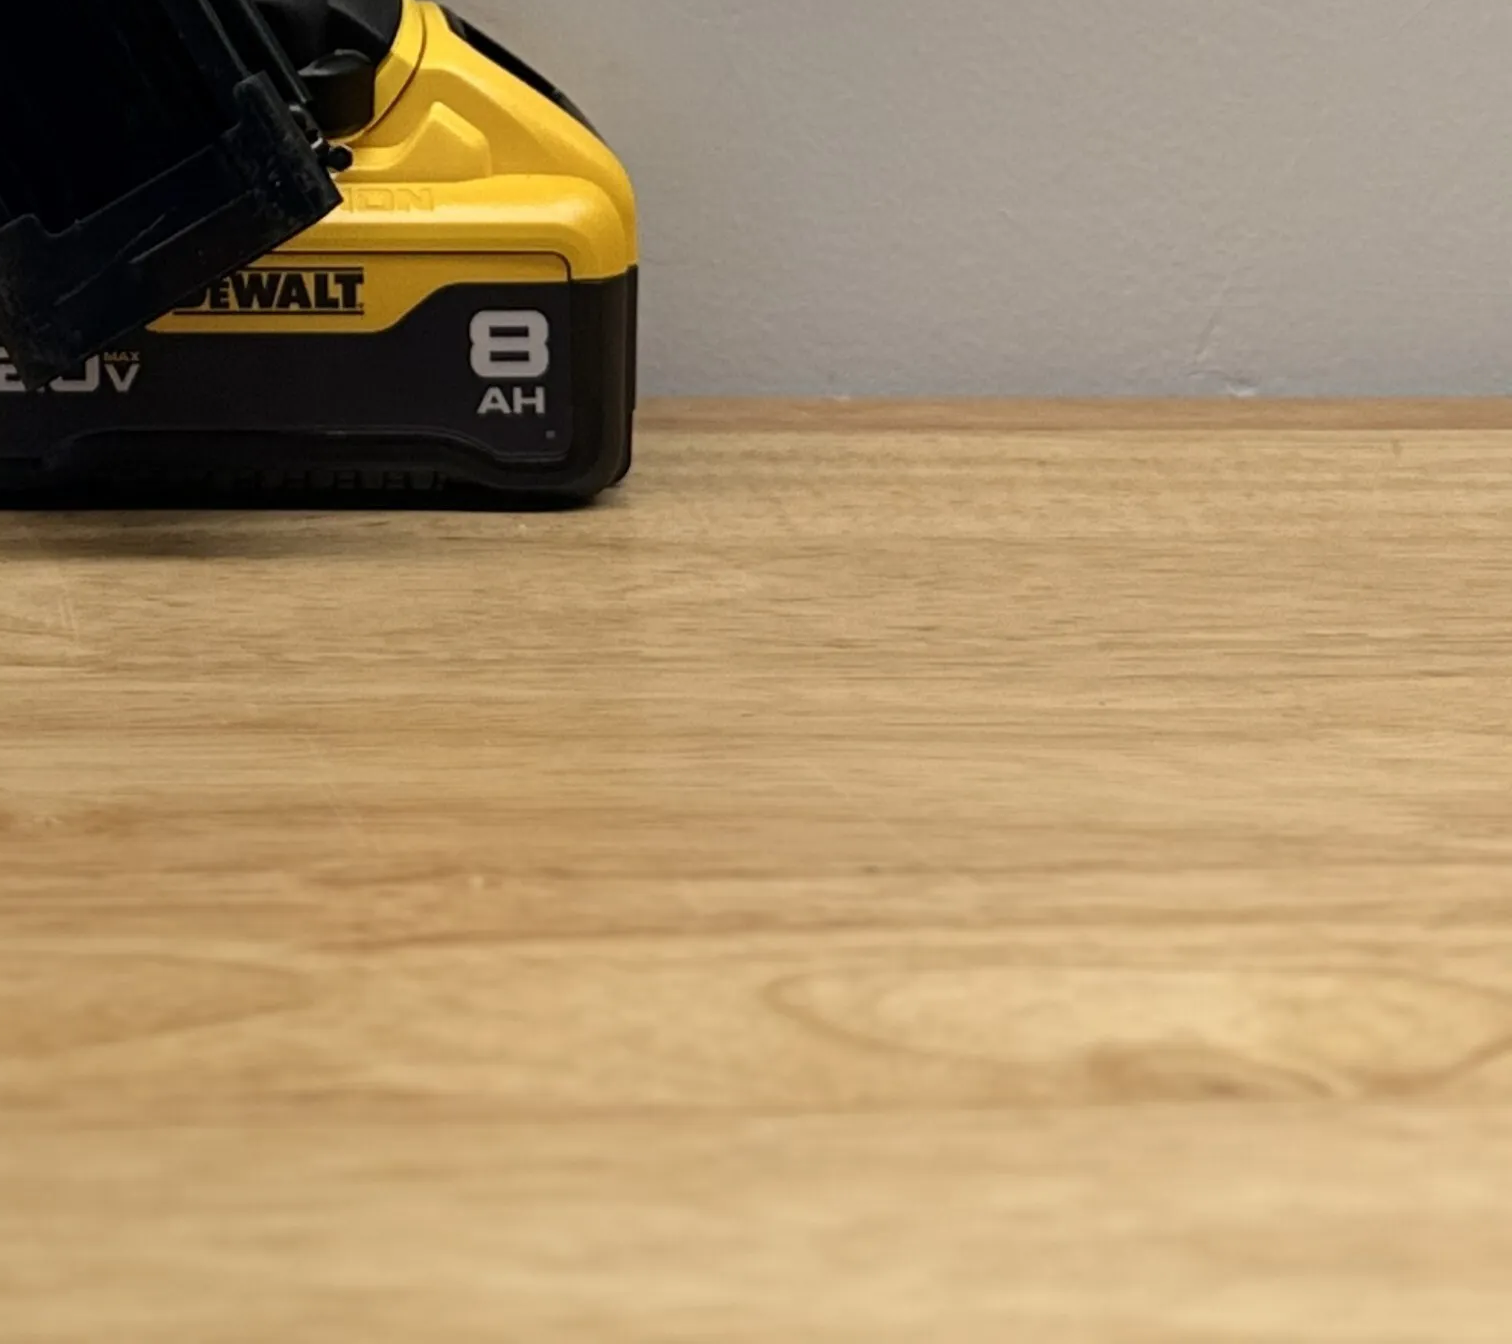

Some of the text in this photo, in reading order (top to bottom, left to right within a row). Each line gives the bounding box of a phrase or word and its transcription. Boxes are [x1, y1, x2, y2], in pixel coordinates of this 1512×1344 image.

[103, 351, 141, 362] MAX
[468, 308, 550, 379] 8
[476, 385, 546, 415] AH
